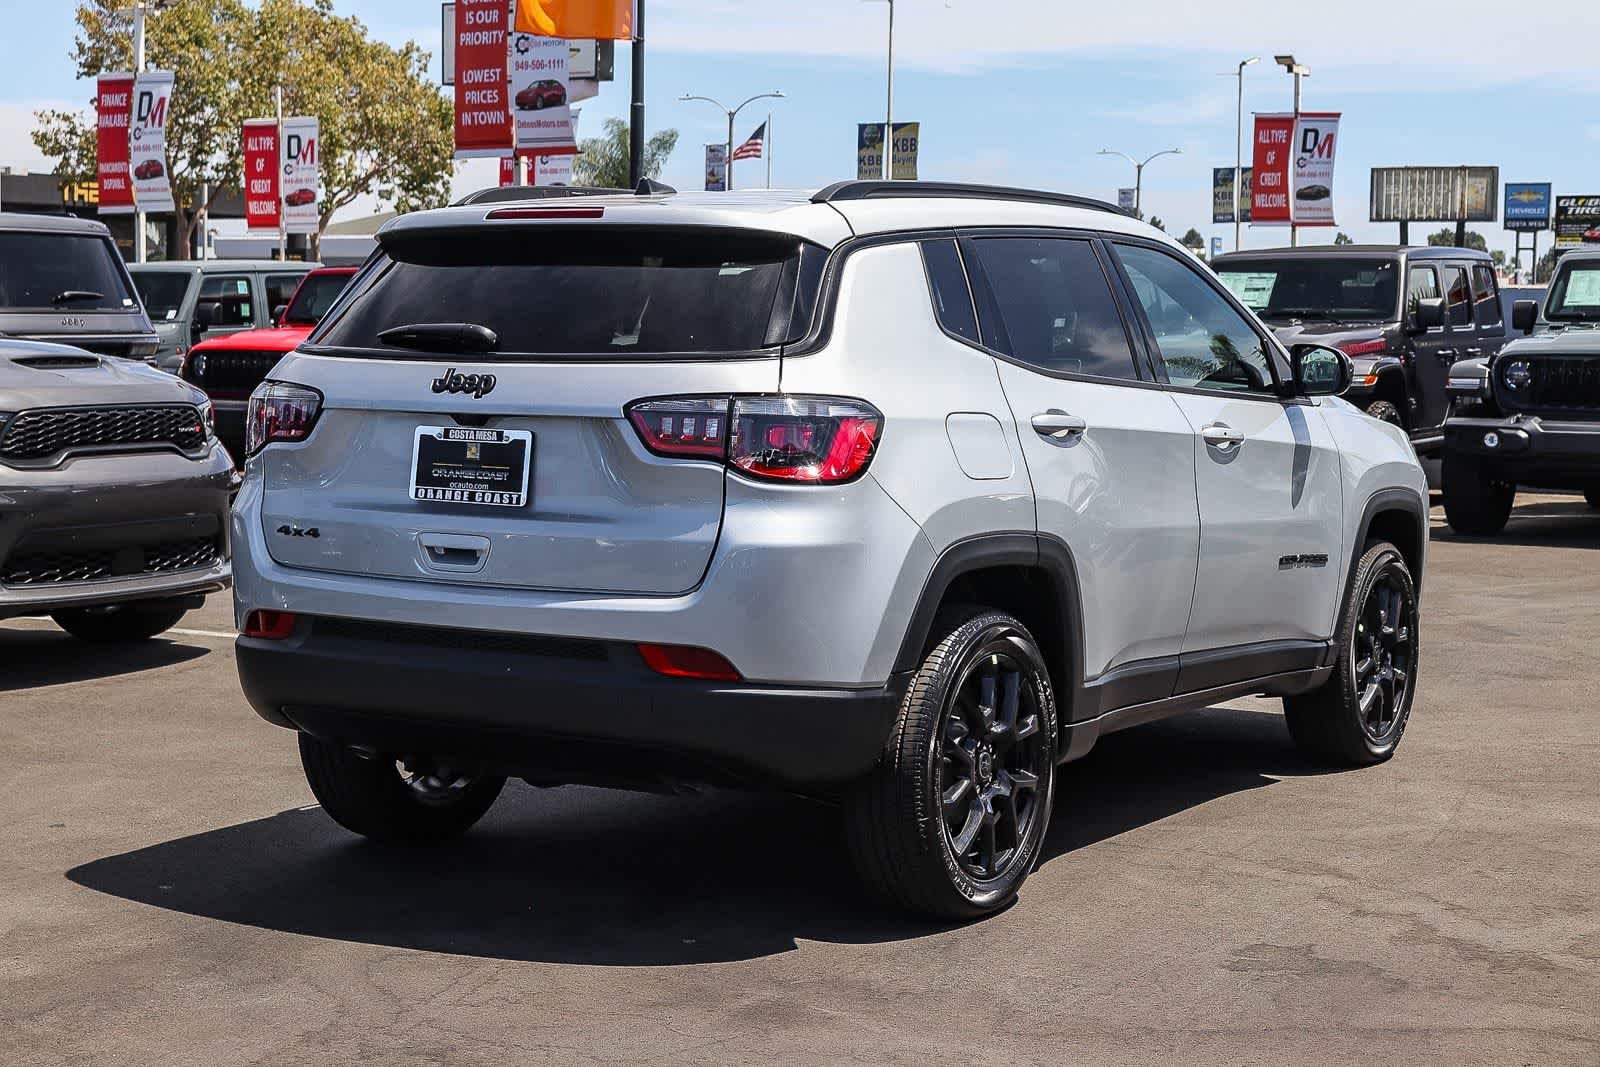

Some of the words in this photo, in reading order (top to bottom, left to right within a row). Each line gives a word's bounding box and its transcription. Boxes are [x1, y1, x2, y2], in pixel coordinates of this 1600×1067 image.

[465, 11, 474, 24] IS
[476, 10, 499, 23] OUR
[460, 30, 504, 46] PRIORITY
[463, 68, 501, 83] LOWEST
[101, 93, 128, 106] FINANCE
[465, 90, 499, 104] PRICES
[138, 91, 166, 128] DM
[98, 113, 129, 128] AVAILABLE
[462, 112, 473, 125] IN
[474, 111, 505, 125] TOWN
[248, 137, 259, 151] ALL
[259, 136, 274, 150] TYPE
[1259, 130, 1270, 144] ALL
[1270, 129, 1287, 143] TYPE
[1301, 128, 1335, 159] DM
[287, 135, 315, 165] DM
[893, 138, 917, 152] KBB
[255, 158, 265, 172] OF
[860, 155, 882, 166] KBB
[1266, 151, 1276, 165] OF
[251, 179, 271, 193] CREDIT
[1260, 172, 1281, 186] CREDIT
[1255, 193, 1287, 207] WELCOME
[248, 201, 276, 215] WELCOME
[430, 368, 497, 399] Jeep
[449, 429, 475, 440] COSTA
[475, 430, 497, 441] MESA
[417, 488, 470, 501] ORANGE
[475, 491, 519, 504] COAST
